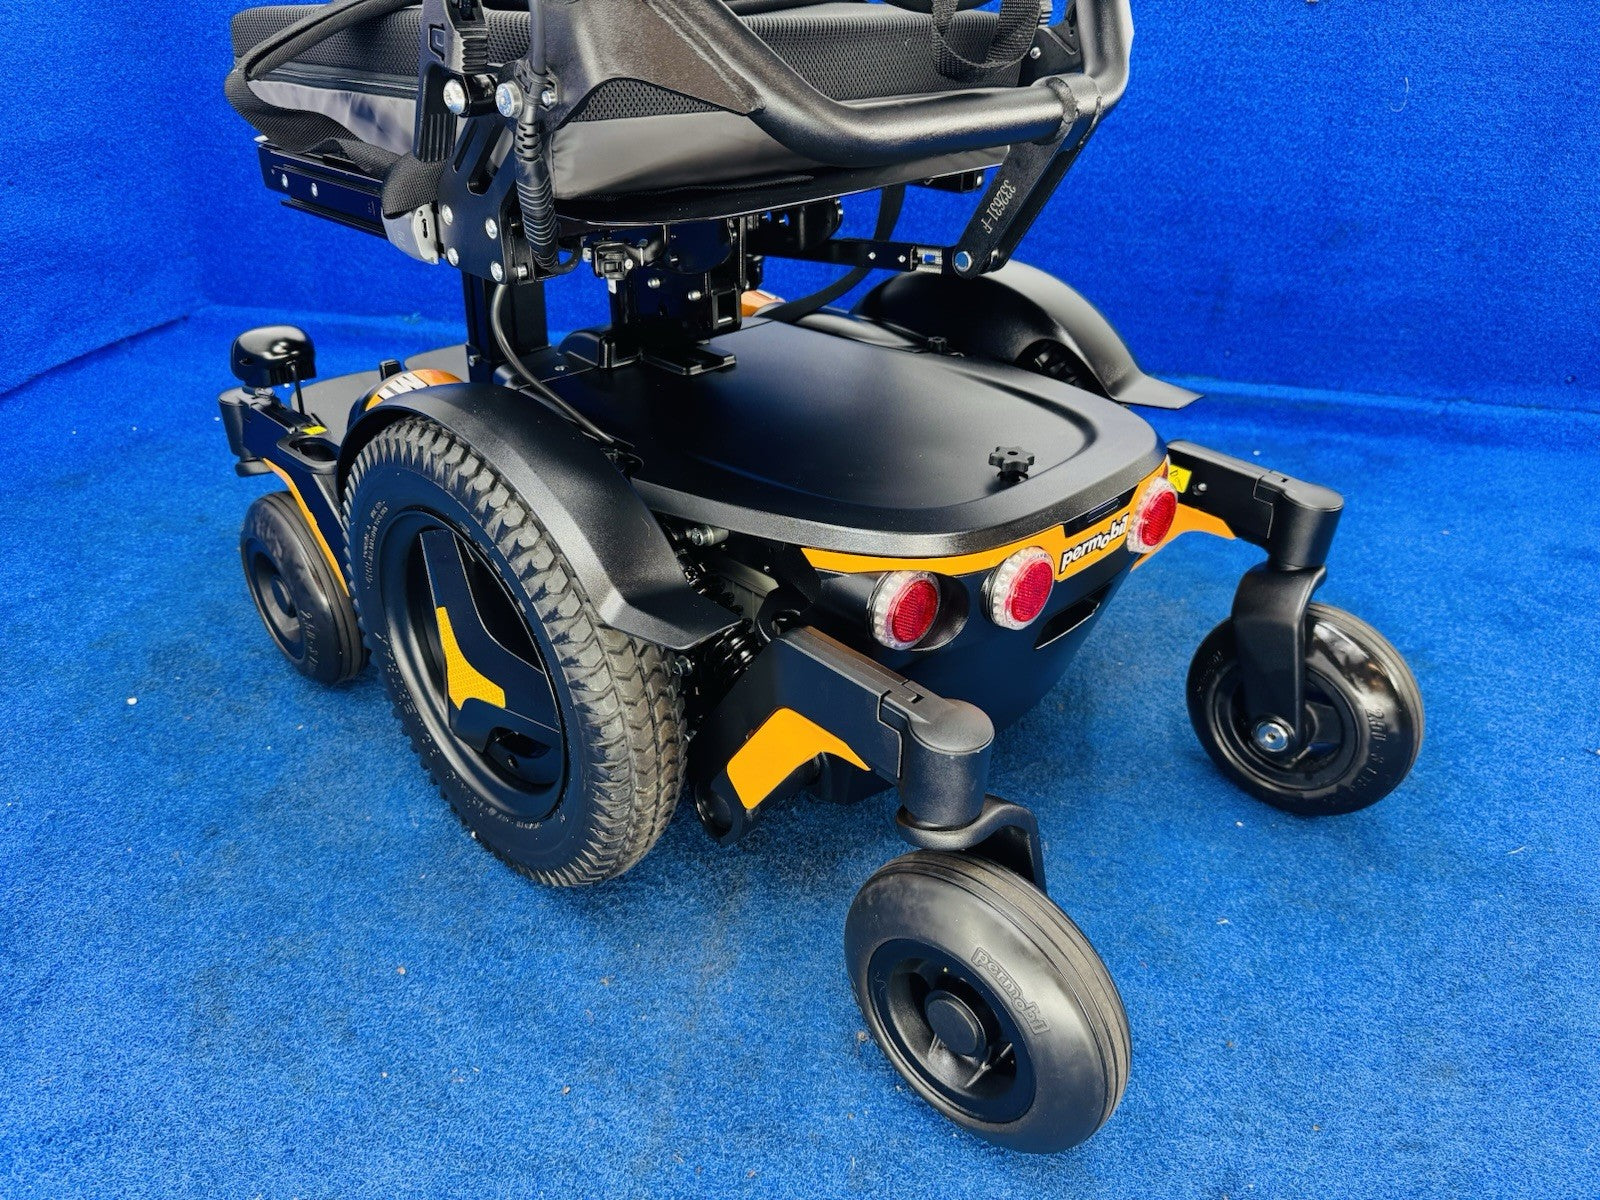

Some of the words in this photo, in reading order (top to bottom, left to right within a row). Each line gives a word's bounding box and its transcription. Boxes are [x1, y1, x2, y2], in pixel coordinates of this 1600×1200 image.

[980, 179, 1016, 235] 332631-F
[1059, 512, 1130, 575] permobil
[971, 946, 1050, 1036] permobil
